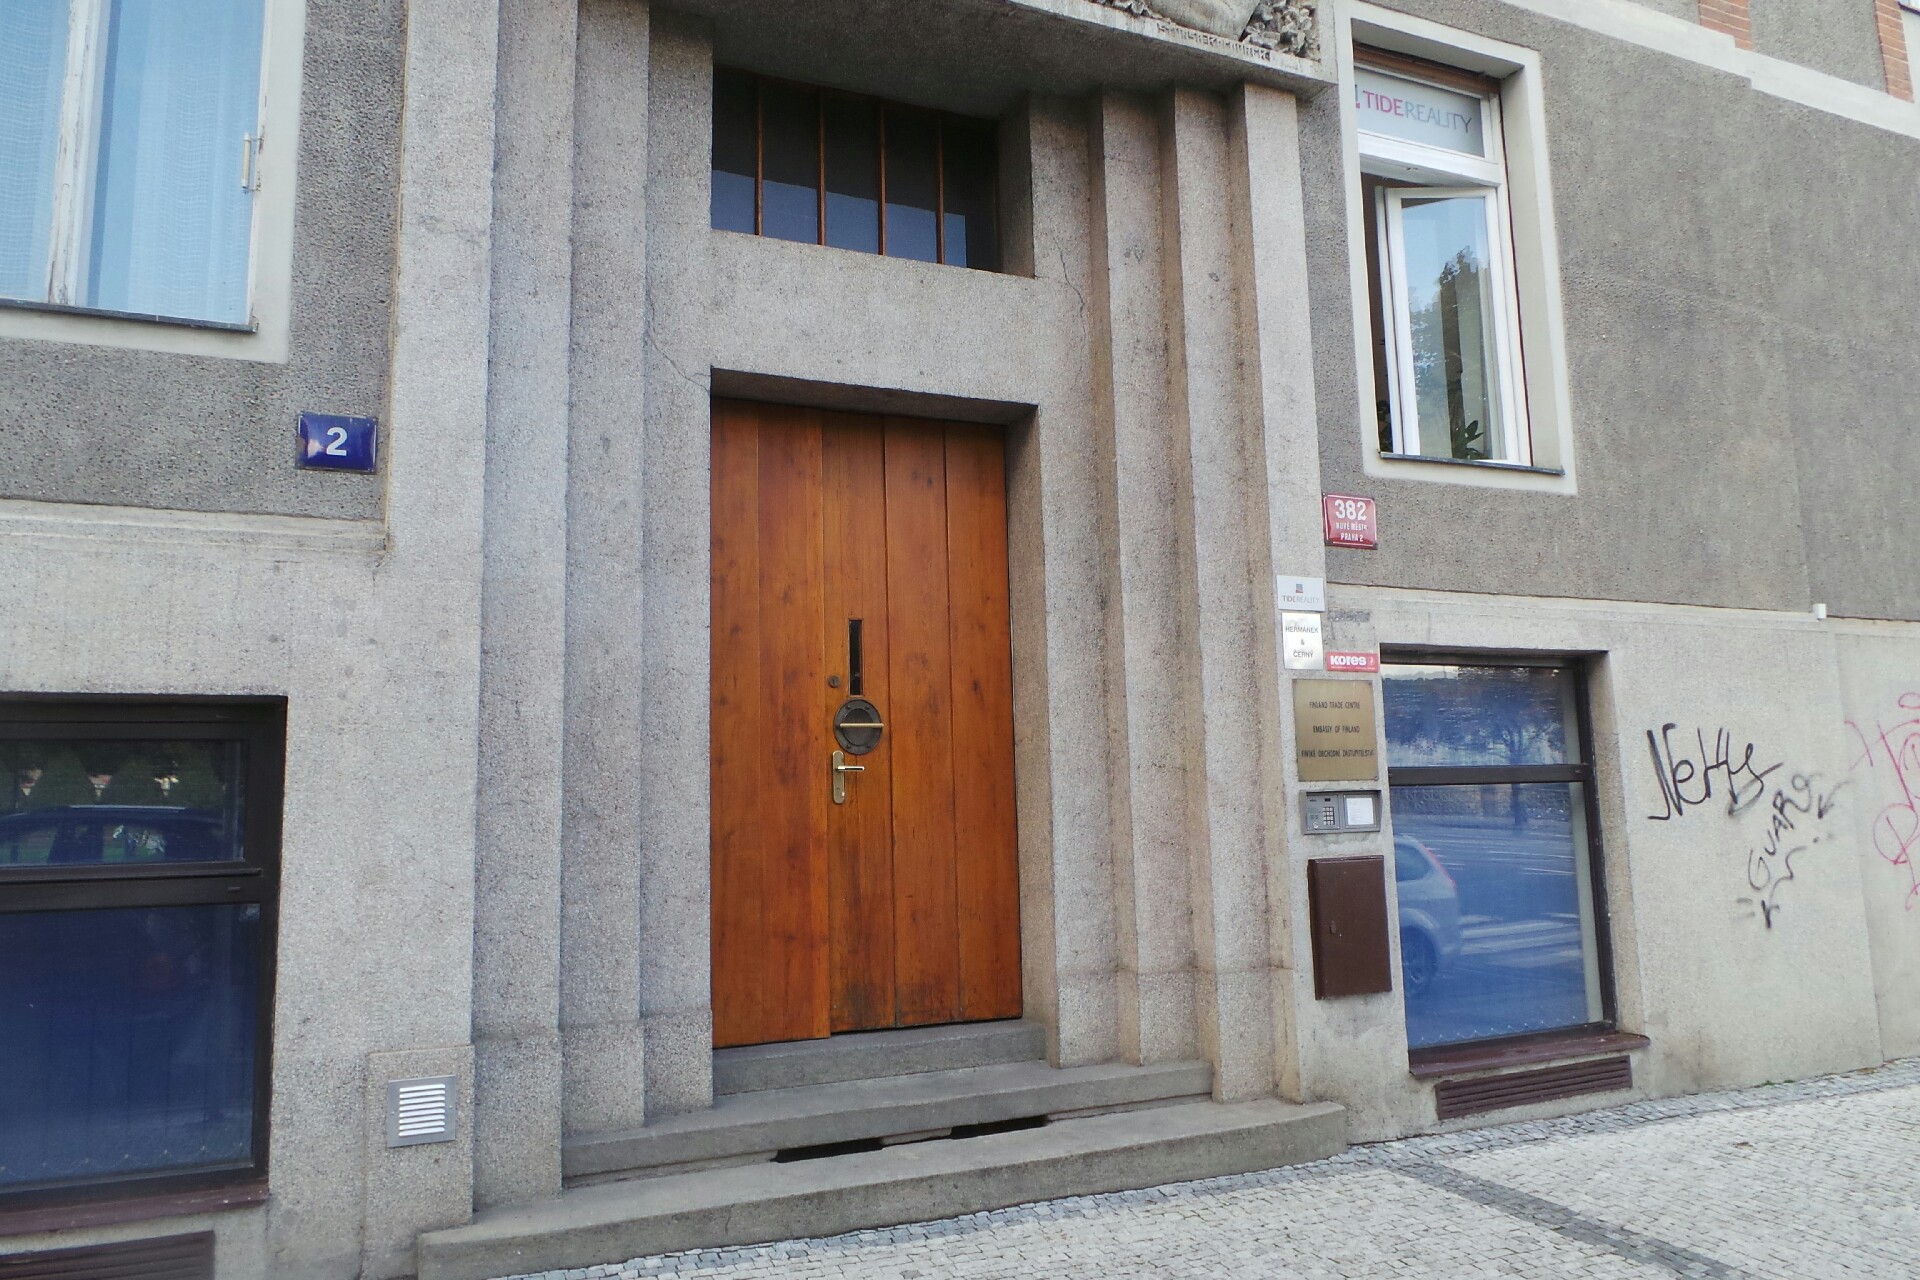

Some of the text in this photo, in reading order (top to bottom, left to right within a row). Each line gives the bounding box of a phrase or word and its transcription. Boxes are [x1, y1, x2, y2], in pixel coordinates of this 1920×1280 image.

[326, 426, 348, 457] 2
[1334, 499, 1367, 521] 382
[1340, 532, 1364, 542] PRAHA 2
[1292, 649, 1314, 658] ČERNÝ
[1345, 701, 1360, 709] CENTRE
[1312, 725, 1360, 733] EMBASSY OF FINLAND
